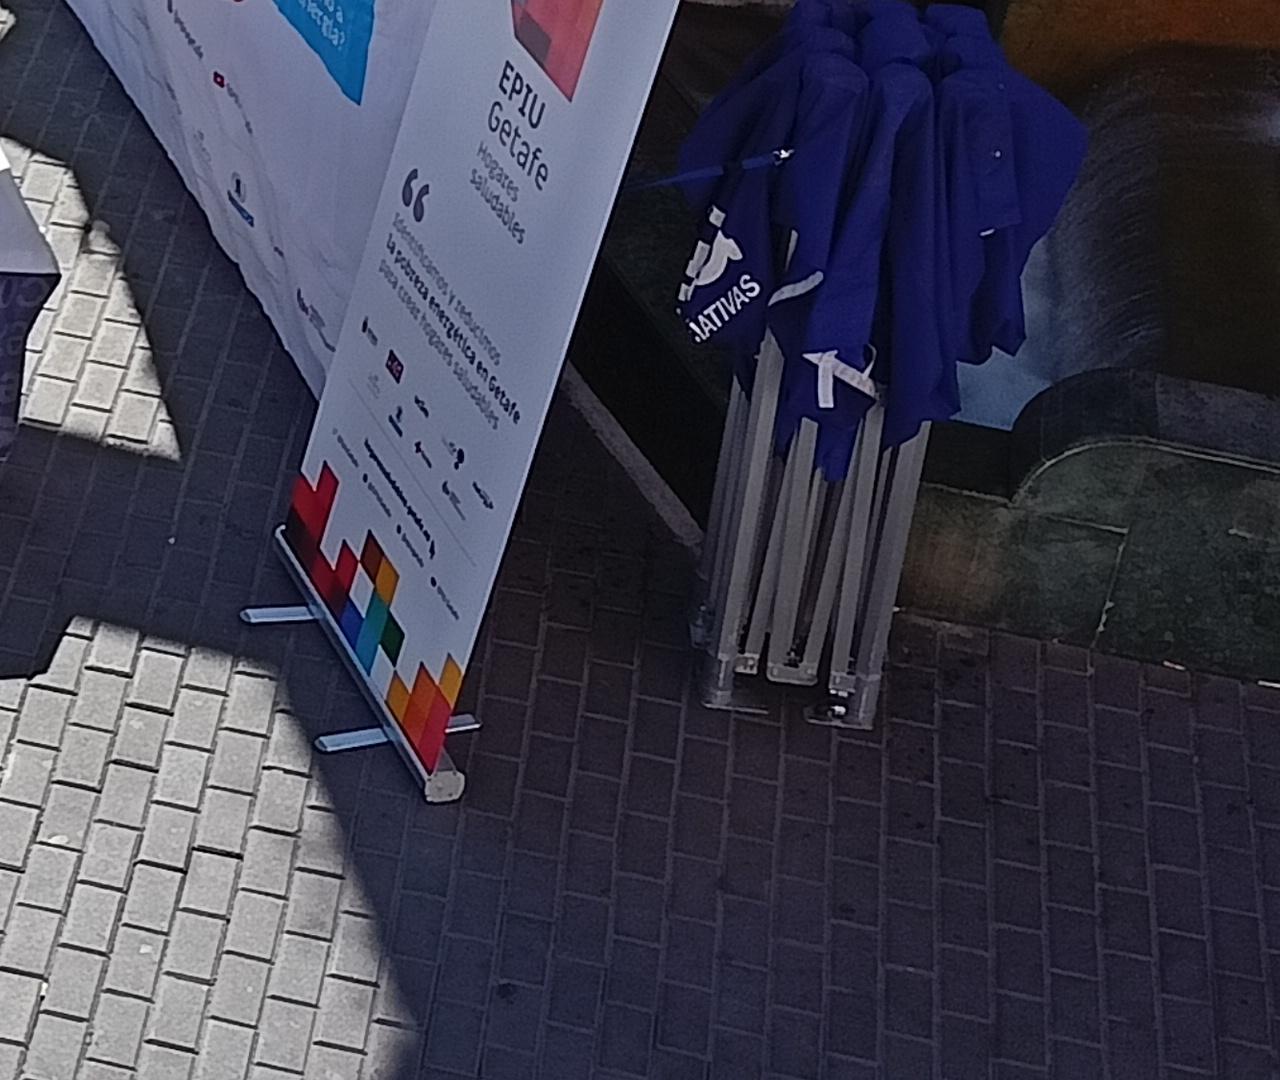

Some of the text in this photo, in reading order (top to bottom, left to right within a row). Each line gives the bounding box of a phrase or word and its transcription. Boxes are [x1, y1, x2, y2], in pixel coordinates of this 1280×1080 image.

[335, 6, 343, 23] a
[498, 59, 546, 130] EPIU
[476, 140, 520, 203] Hogares
[487, 101, 549, 191] Getafe
[469, 167, 526, 245] saludables
[386, 232, 521, 425] la pobreza energética en Getafe
[448, 289, 456, 307] y
[456, 299, 502, 366] reducimos
